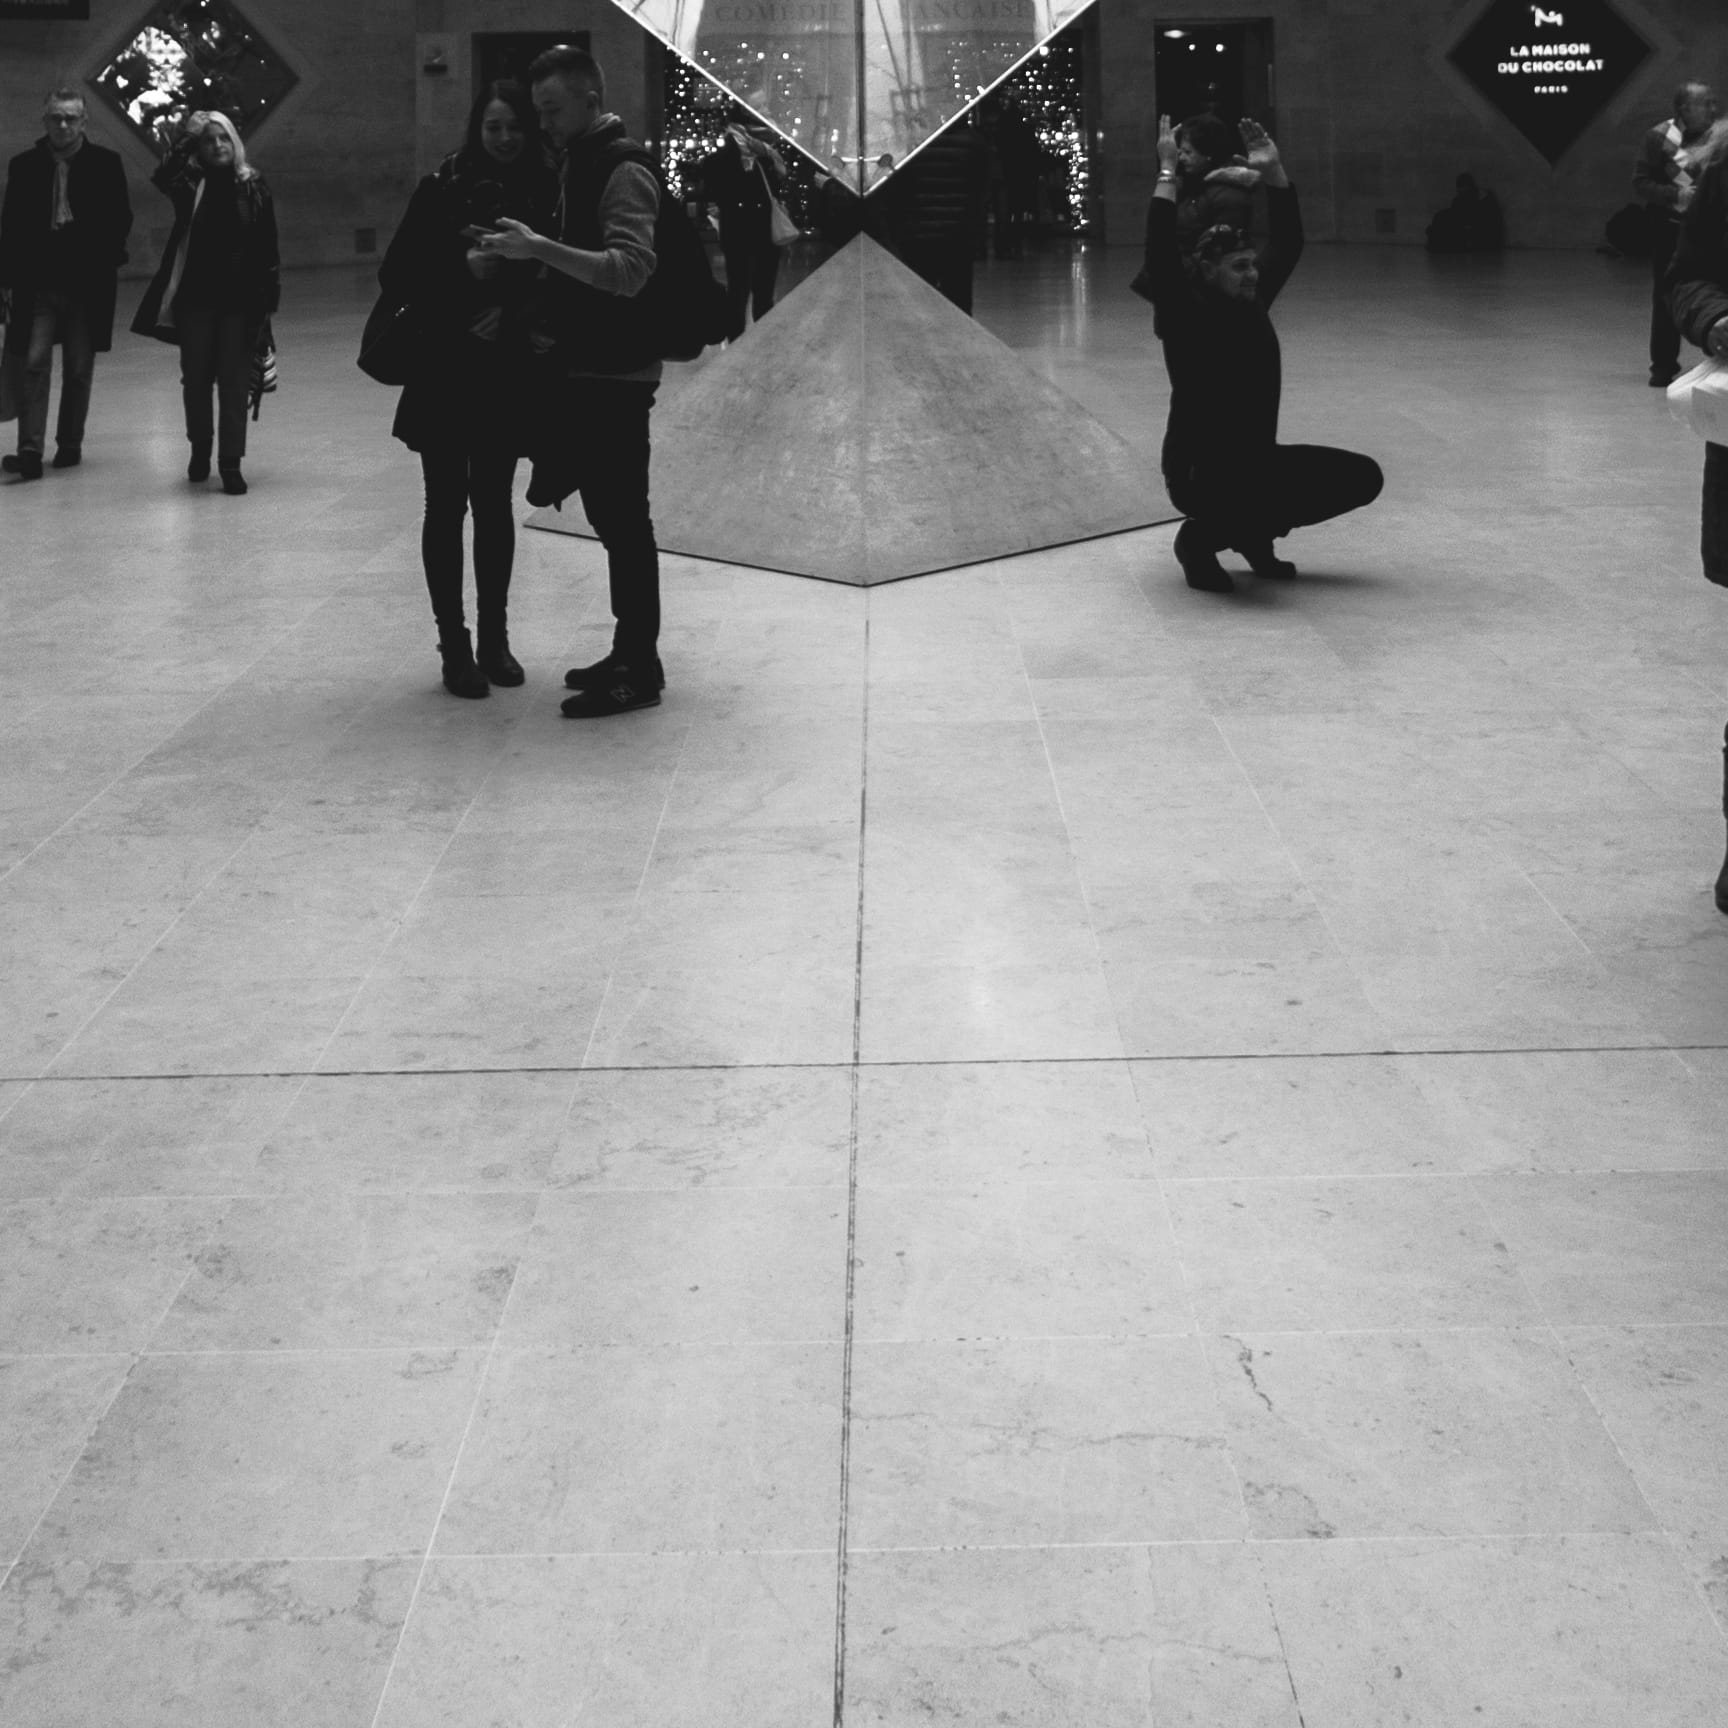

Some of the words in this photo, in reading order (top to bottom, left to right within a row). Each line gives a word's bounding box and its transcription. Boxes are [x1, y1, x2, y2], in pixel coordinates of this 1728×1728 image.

[1509, 44, 1530, 58] LA
[1531, 42, 1592, 57] MAISON
[1497, 61, 1520, 75] DU
[1521, 58, 1605, 74] CHOCOLAT
[1533, 84, 1569, 95] PARIS
